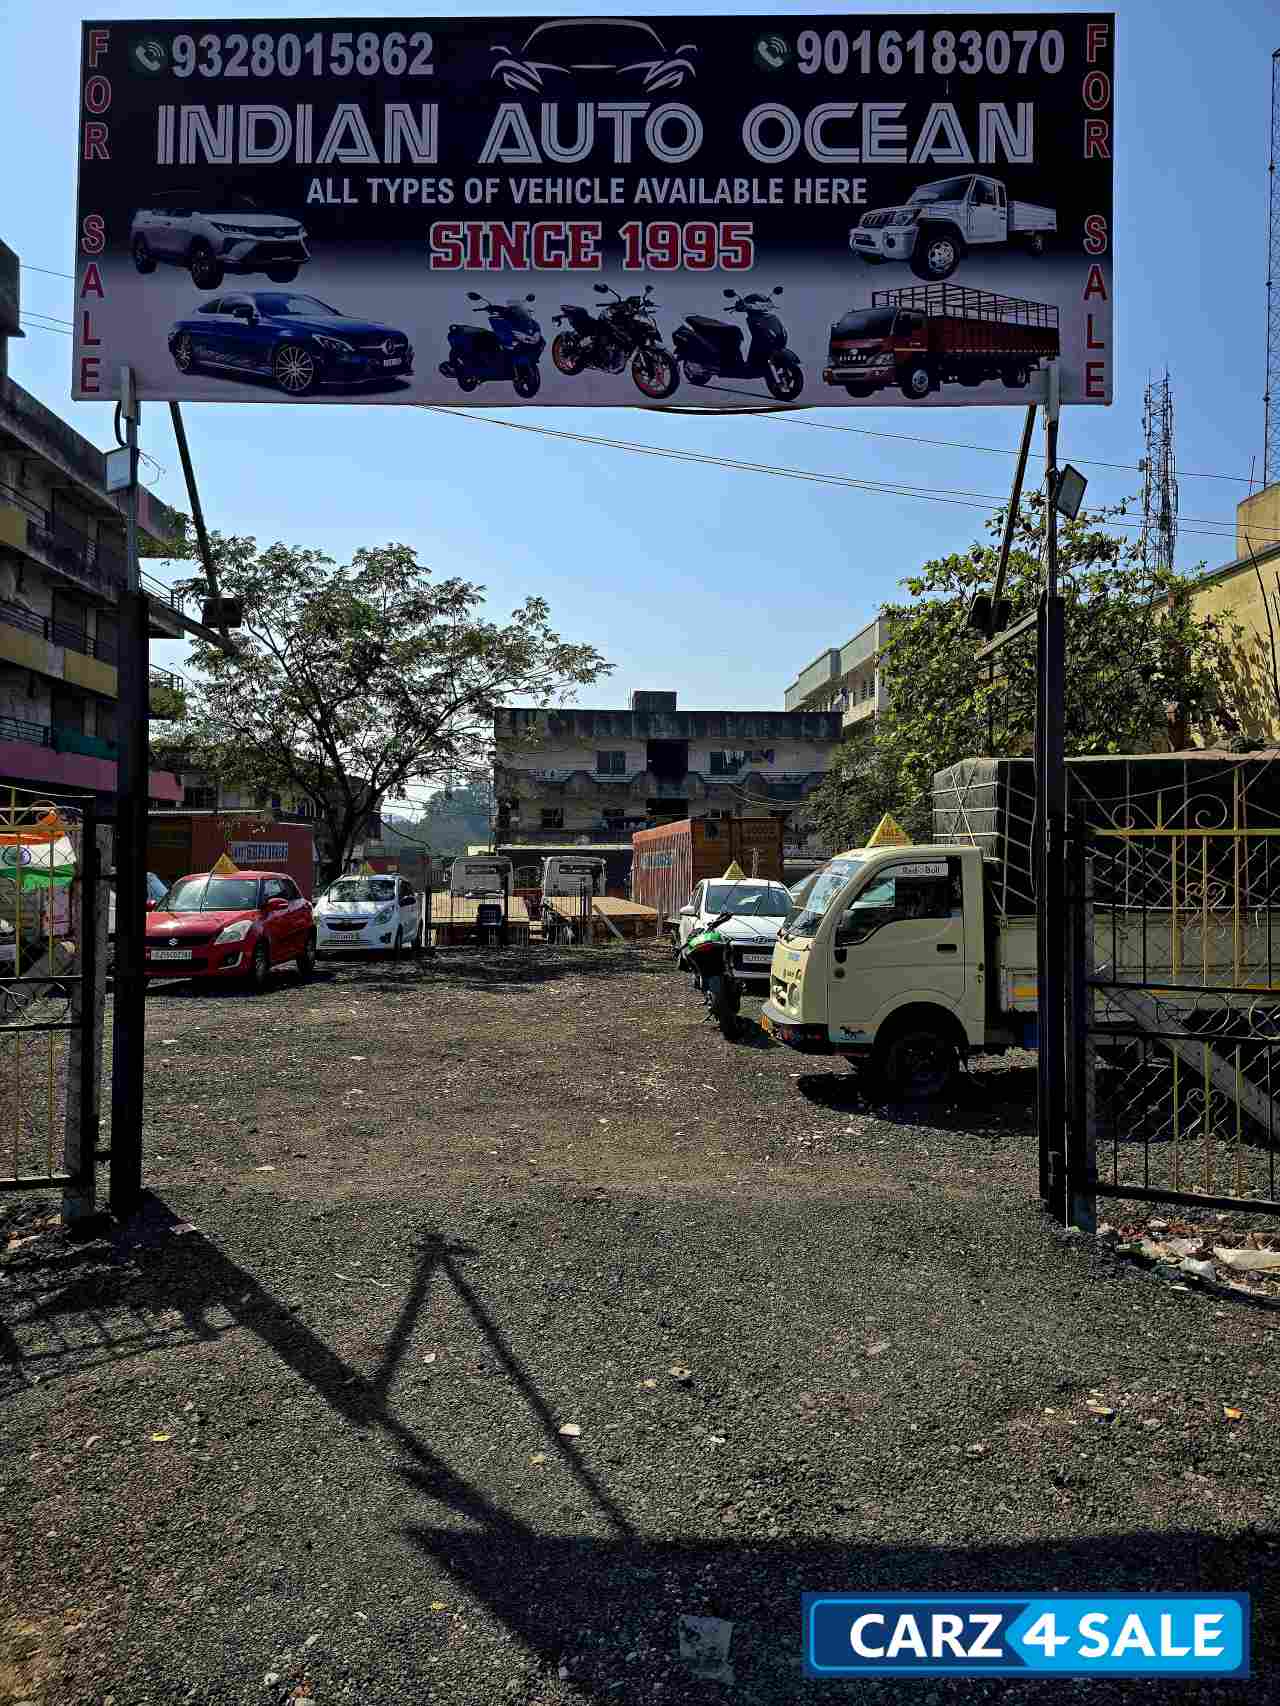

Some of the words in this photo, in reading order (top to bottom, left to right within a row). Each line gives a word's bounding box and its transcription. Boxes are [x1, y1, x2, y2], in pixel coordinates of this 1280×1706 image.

[172, 32, 434, 77] 9328015862
[797, 29, 1065, 75] 9016183070
[84, 29, 112, 161] FOR
[1082, 24, 1111, 160] FOR
[156, 103, 439, 165] INDIAN
[478, 102, 704, 164] AUTO
[742, 102, 1035, 164] OCEAN
[306, 177, 358, 205] ALL
[366, 177, 455, 205] TYPES
[464, 177, 500, 205] OF
[508, 177, 625, 205] VEHICLE
[633, 177, 784, 205] AVAILABLE
[794, 177, 867, 205] HERE
[428, 220, 603, 272] SINCE
[619, 220, 754, 272] 1995
[80, 214, 107, 395] SALE
[1082, 214, 1109, 399] SALE
